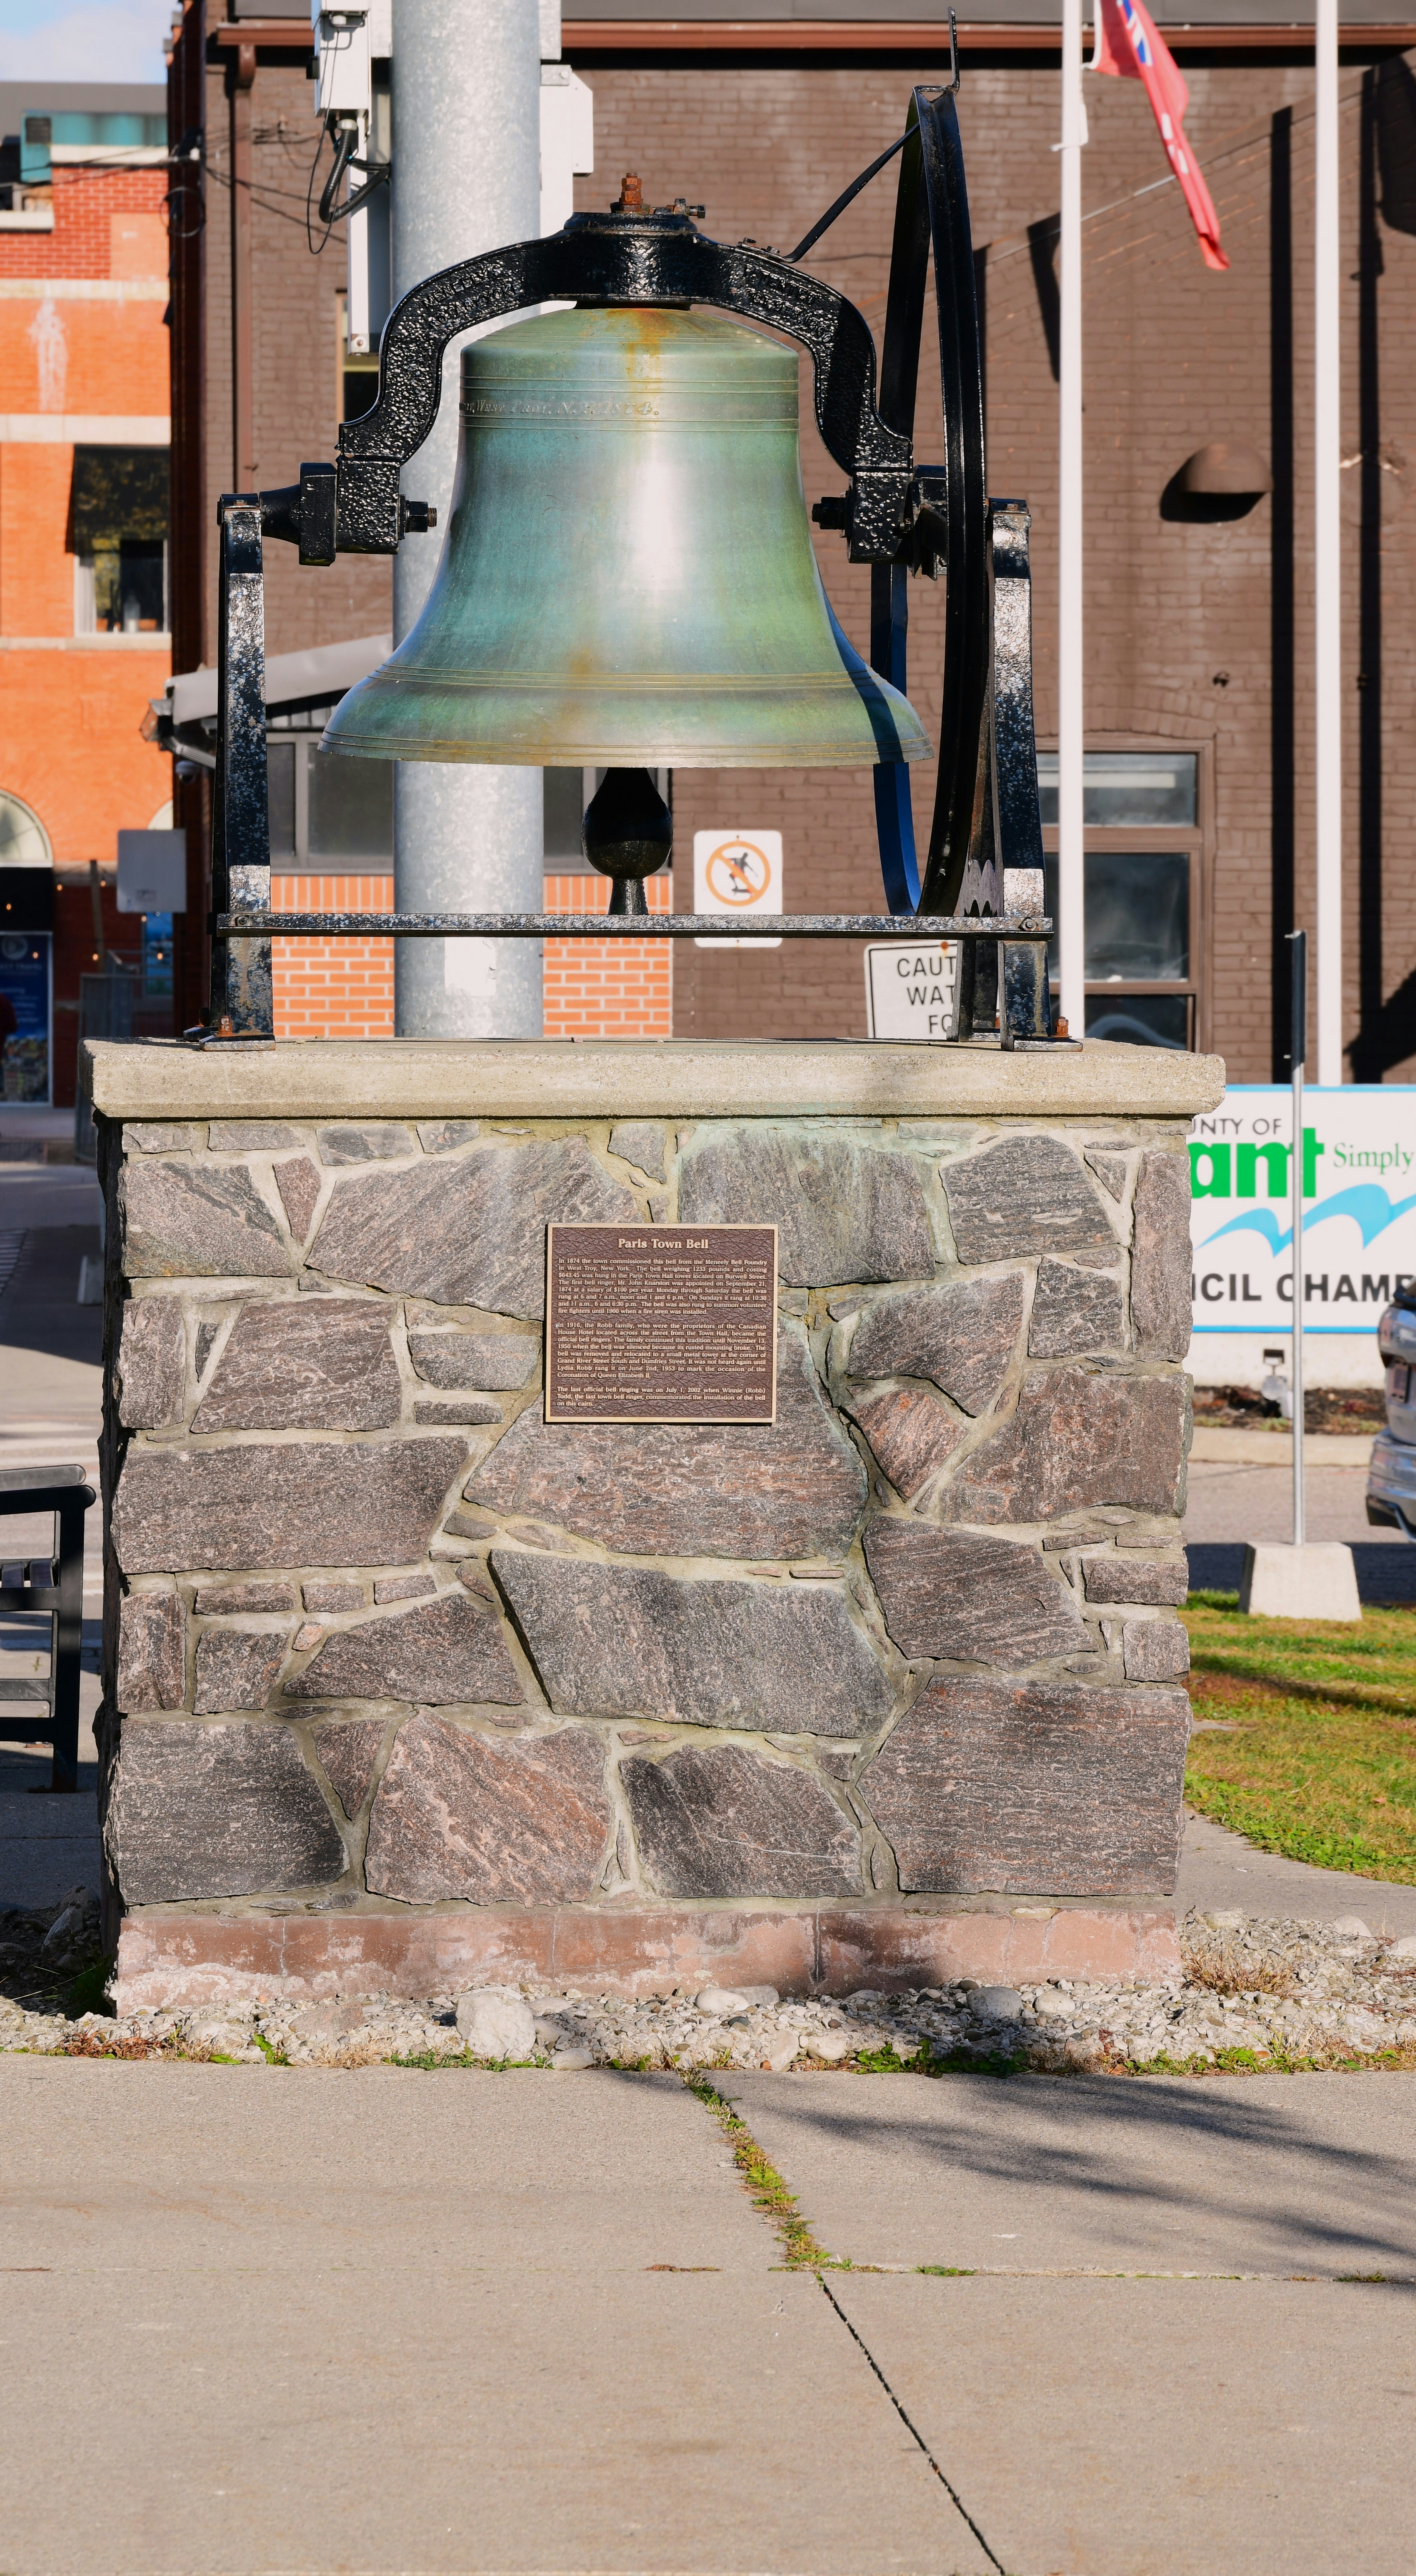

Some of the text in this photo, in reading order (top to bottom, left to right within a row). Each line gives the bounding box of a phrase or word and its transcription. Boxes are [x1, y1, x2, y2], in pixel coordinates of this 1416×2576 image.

[897, 956, 956, 977] CAUT
[907, 985, 954, 1005] WAT
[1253, 1118, 1281, 1135] OF
[1333, 1142, 1414, 1175] Simply
[618, 1238, 709, 1249] Paris Town Bell
[1193, 1273, 1261, 1302] CIL
